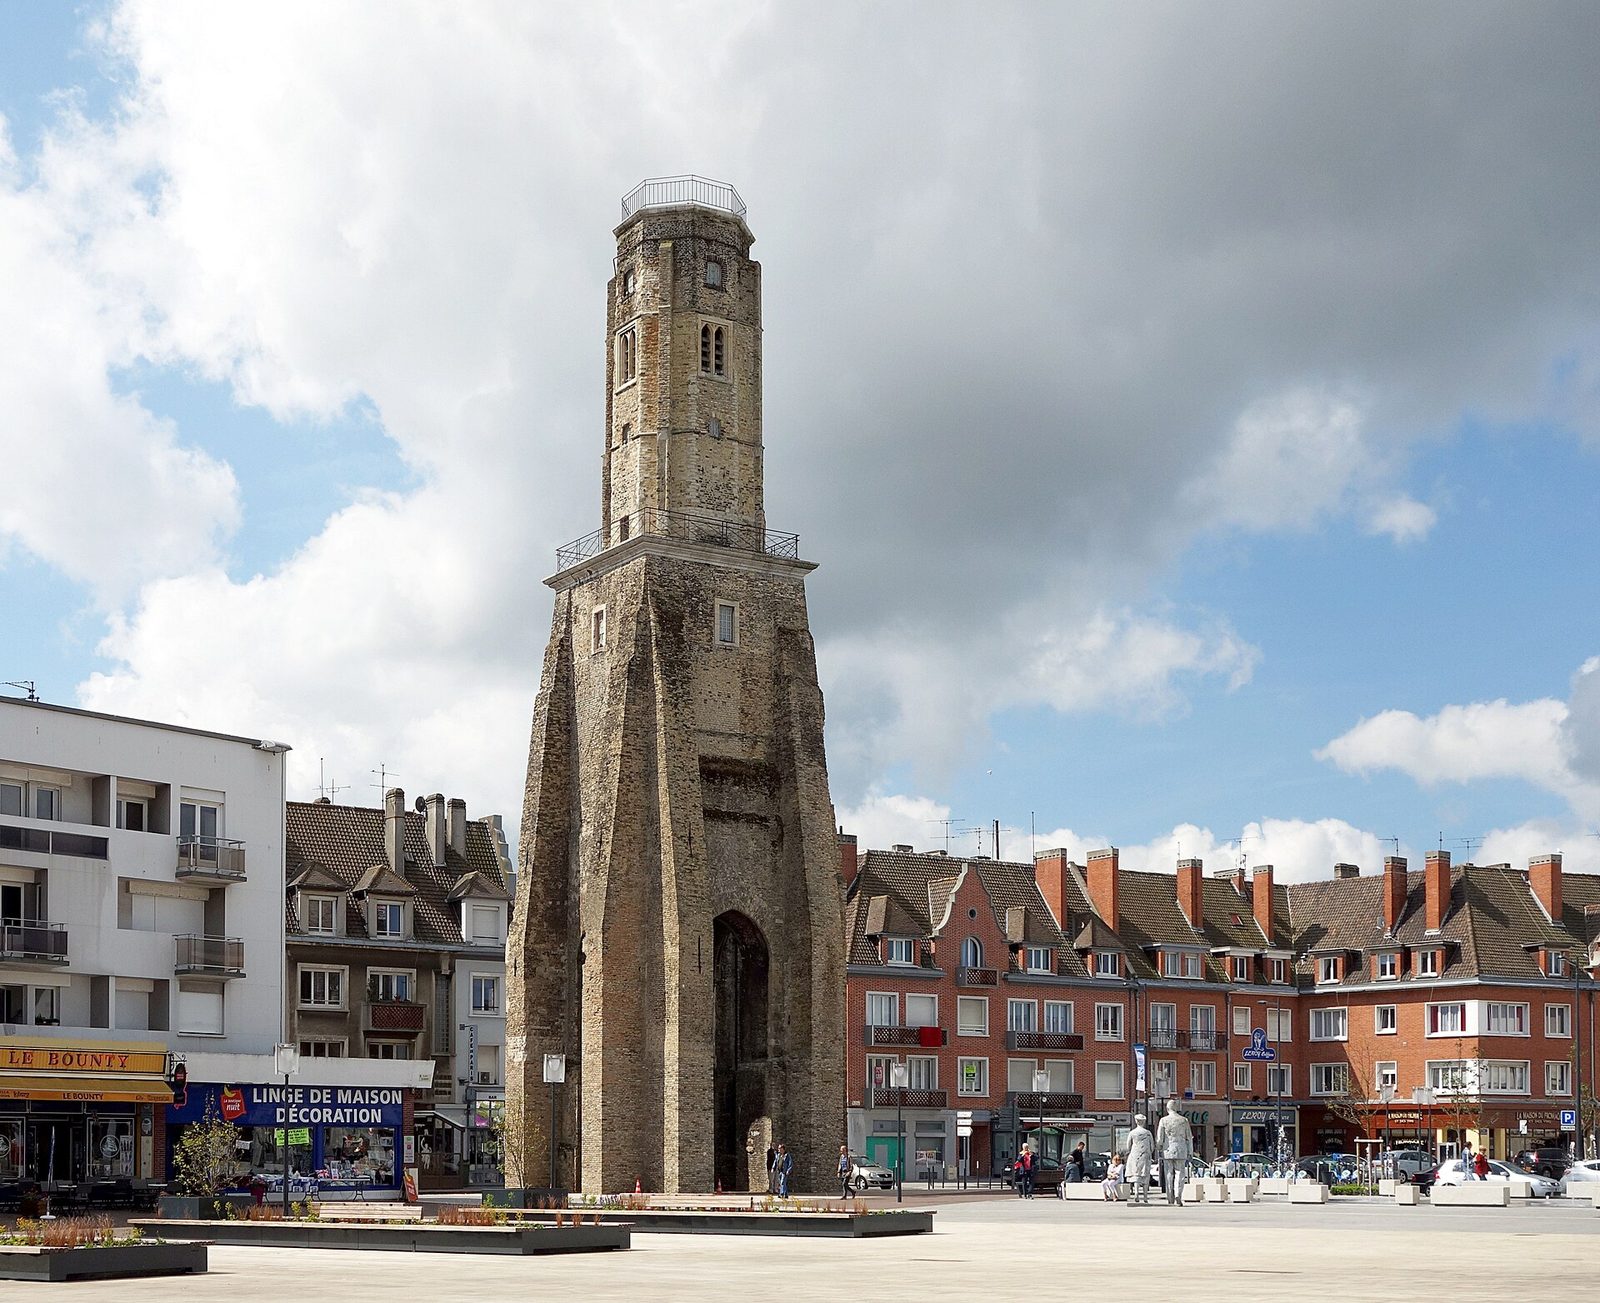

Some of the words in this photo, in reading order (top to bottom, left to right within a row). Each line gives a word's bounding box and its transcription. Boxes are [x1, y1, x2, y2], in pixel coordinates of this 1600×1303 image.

[1244, 1050, 1260, 1058] LEROY
[8, 1051, 33, 1064] LE
[49, 1052, 129, 1068] BOUNTY
[63, 1092, 71, 1100] LE
[73, 1093, 104, 1101] BOUNTY
[253, 1087, 303, 1104] LINGE
[310, 1088, 331, 1104] DE
[337, 1089, 402, 1105] MAISON
[226, 1102, 240, 1111] nuit
[276, 1104, 382, 1123] DÉCORATION
[1240, 1111, 1267, 1122] LEROY
[1564, 1113, 1572, 1123] P
